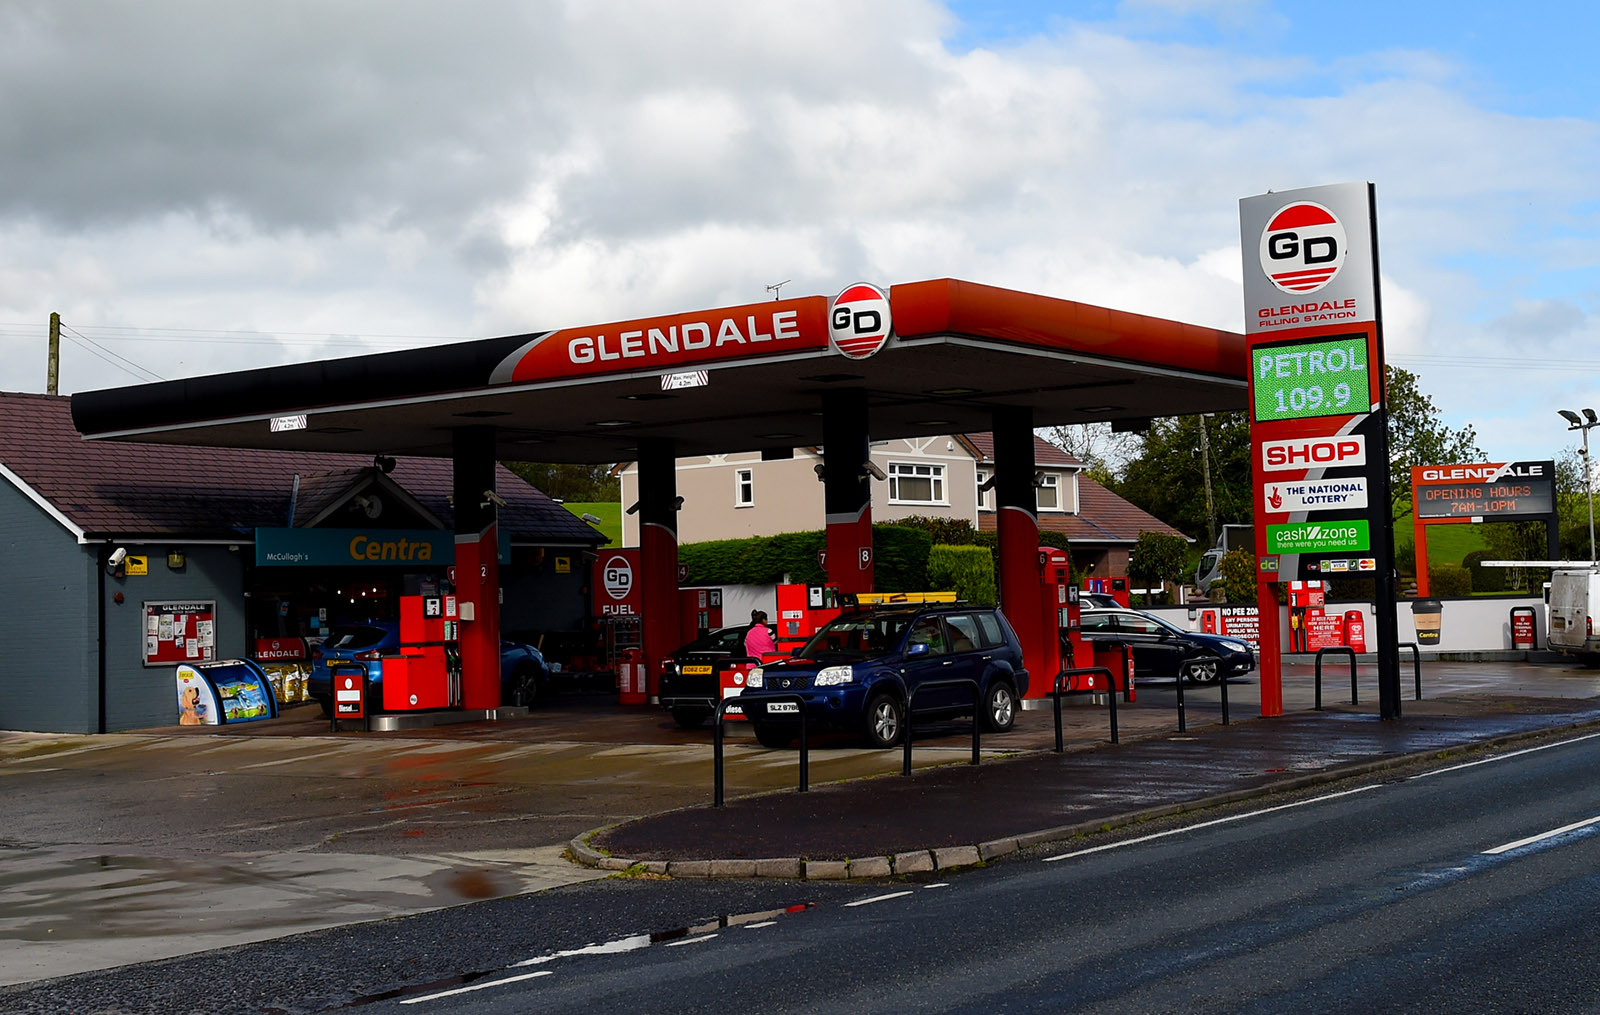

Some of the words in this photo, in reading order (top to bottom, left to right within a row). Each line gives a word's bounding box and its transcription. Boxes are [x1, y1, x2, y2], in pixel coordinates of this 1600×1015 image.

[1268, 231, 1338, 265] GD
[1258, 298, 1356, 318] GLENDALE
[832, 306, 882, 335] GD
[1259, 316, 1300, 327] FILLING
[1303, 311, 1356, 323] STATION
[567, 310, 801, 365] GLENDALE
[1260, 346, 1365, 379] PETROL
[1274, 382, 1351, 413] 109.9
[1266, 441, 1360, 466] SHOP
[1422, 465, 1544, 481] GLENDALE
[1286, 486, 1305, 495] THE
[1308, 483, 1364, 494] NATIONAL
[1425, 487, 1482, 501] OPENING
[1490, 485, 1531, 498] HOURS
[1302, 494, 1348, 505] LOTTERY
[1450, 500, 1517, 513] 7AM-10PM
[350, 535, 433, 561] Centra
[1277, 541, 1294, 549] there
[1313, 540, 1326, 549] you
[820, 553, 826, 564] 7
[862, 550, 869, 562] 8
[1039, 553, 1046, 564] 6
[481, 566, 487, 577] 2
[679, 566, 686, 575] 4
[1260, 560, 1279, 570] dci
[450, 569, 455, 580] 1
[607, 569, 629, 586] GD
[602, 604, 635, 615] FUEL
[1221, 607, 1232, 616] NO
[1232, 607, 1246, 616] PEE
[1246, 607, 1259, 616] ZON
